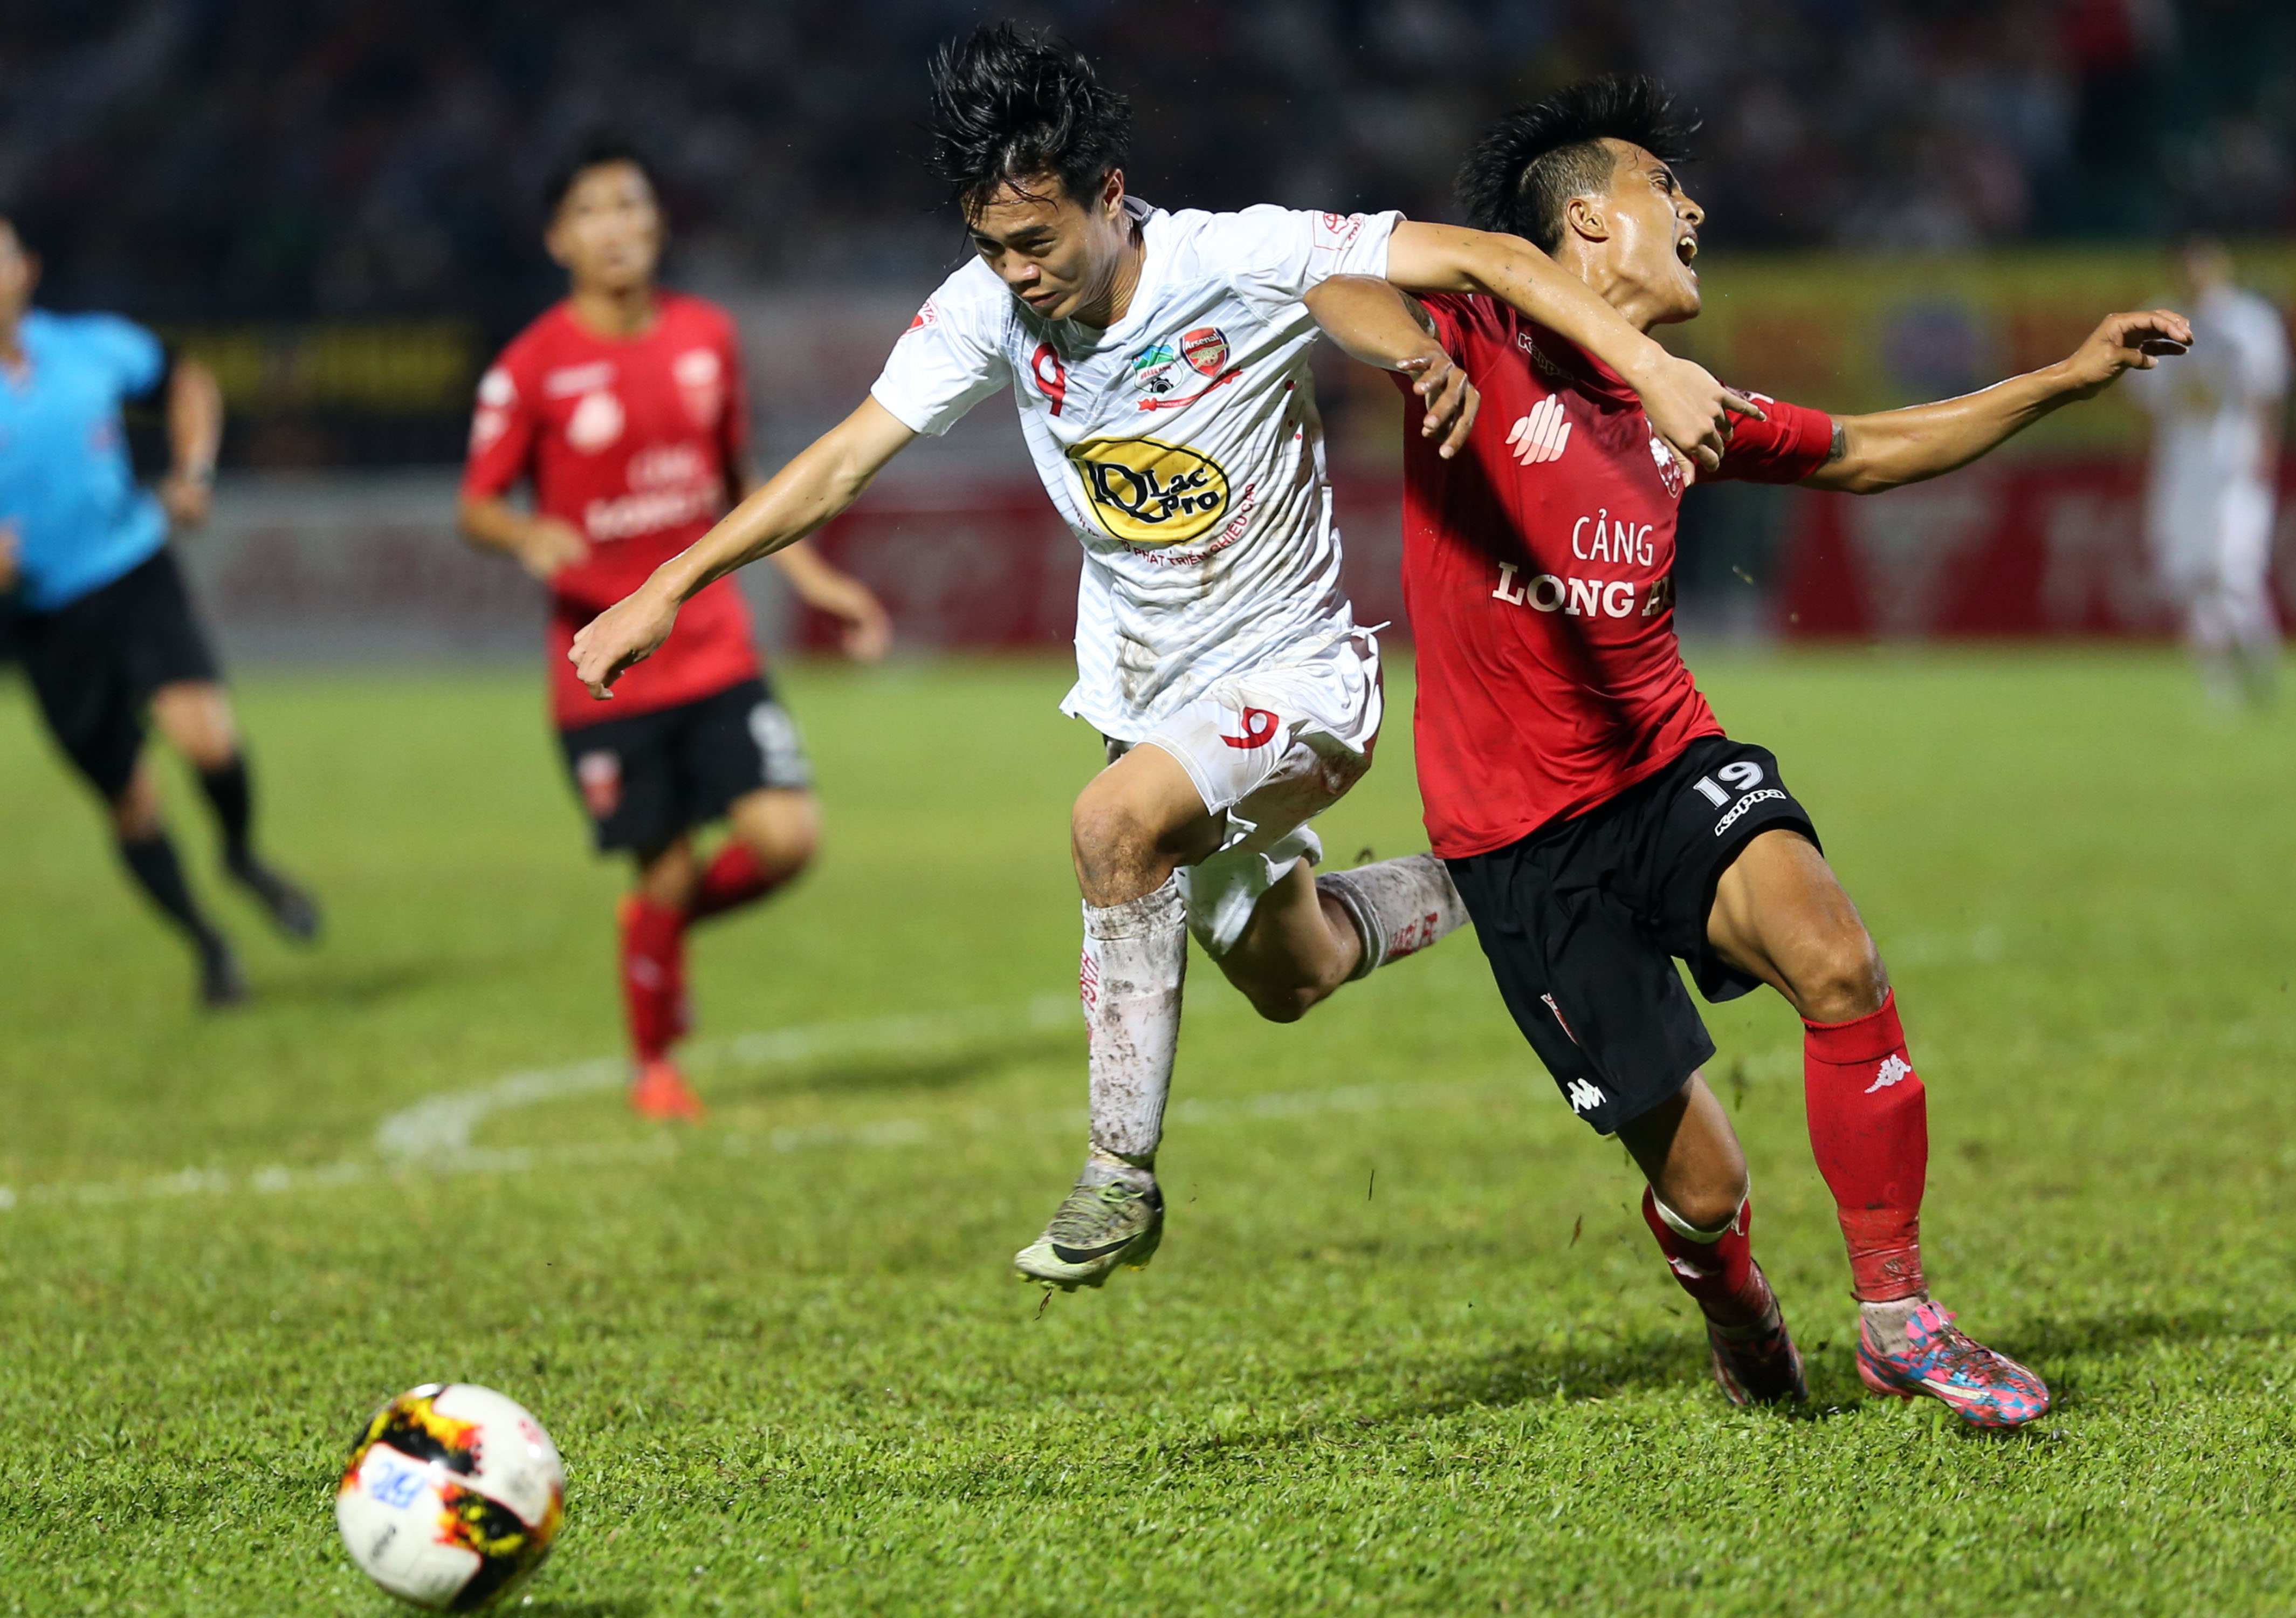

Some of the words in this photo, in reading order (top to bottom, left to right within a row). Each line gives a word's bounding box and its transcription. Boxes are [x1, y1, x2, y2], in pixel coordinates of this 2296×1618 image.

[1185, 333, 1220, 351] Arsenal
[1031, 341, 1065, 417] 9
[1159, 491, 1221, 518] Pro
[1572, 508, 1654, 567] CẢNG
[1491, 561, 1635, 619] LONG
[1641, 575, 1675, 617] A
[1693, 761, 1764, 808] 19
